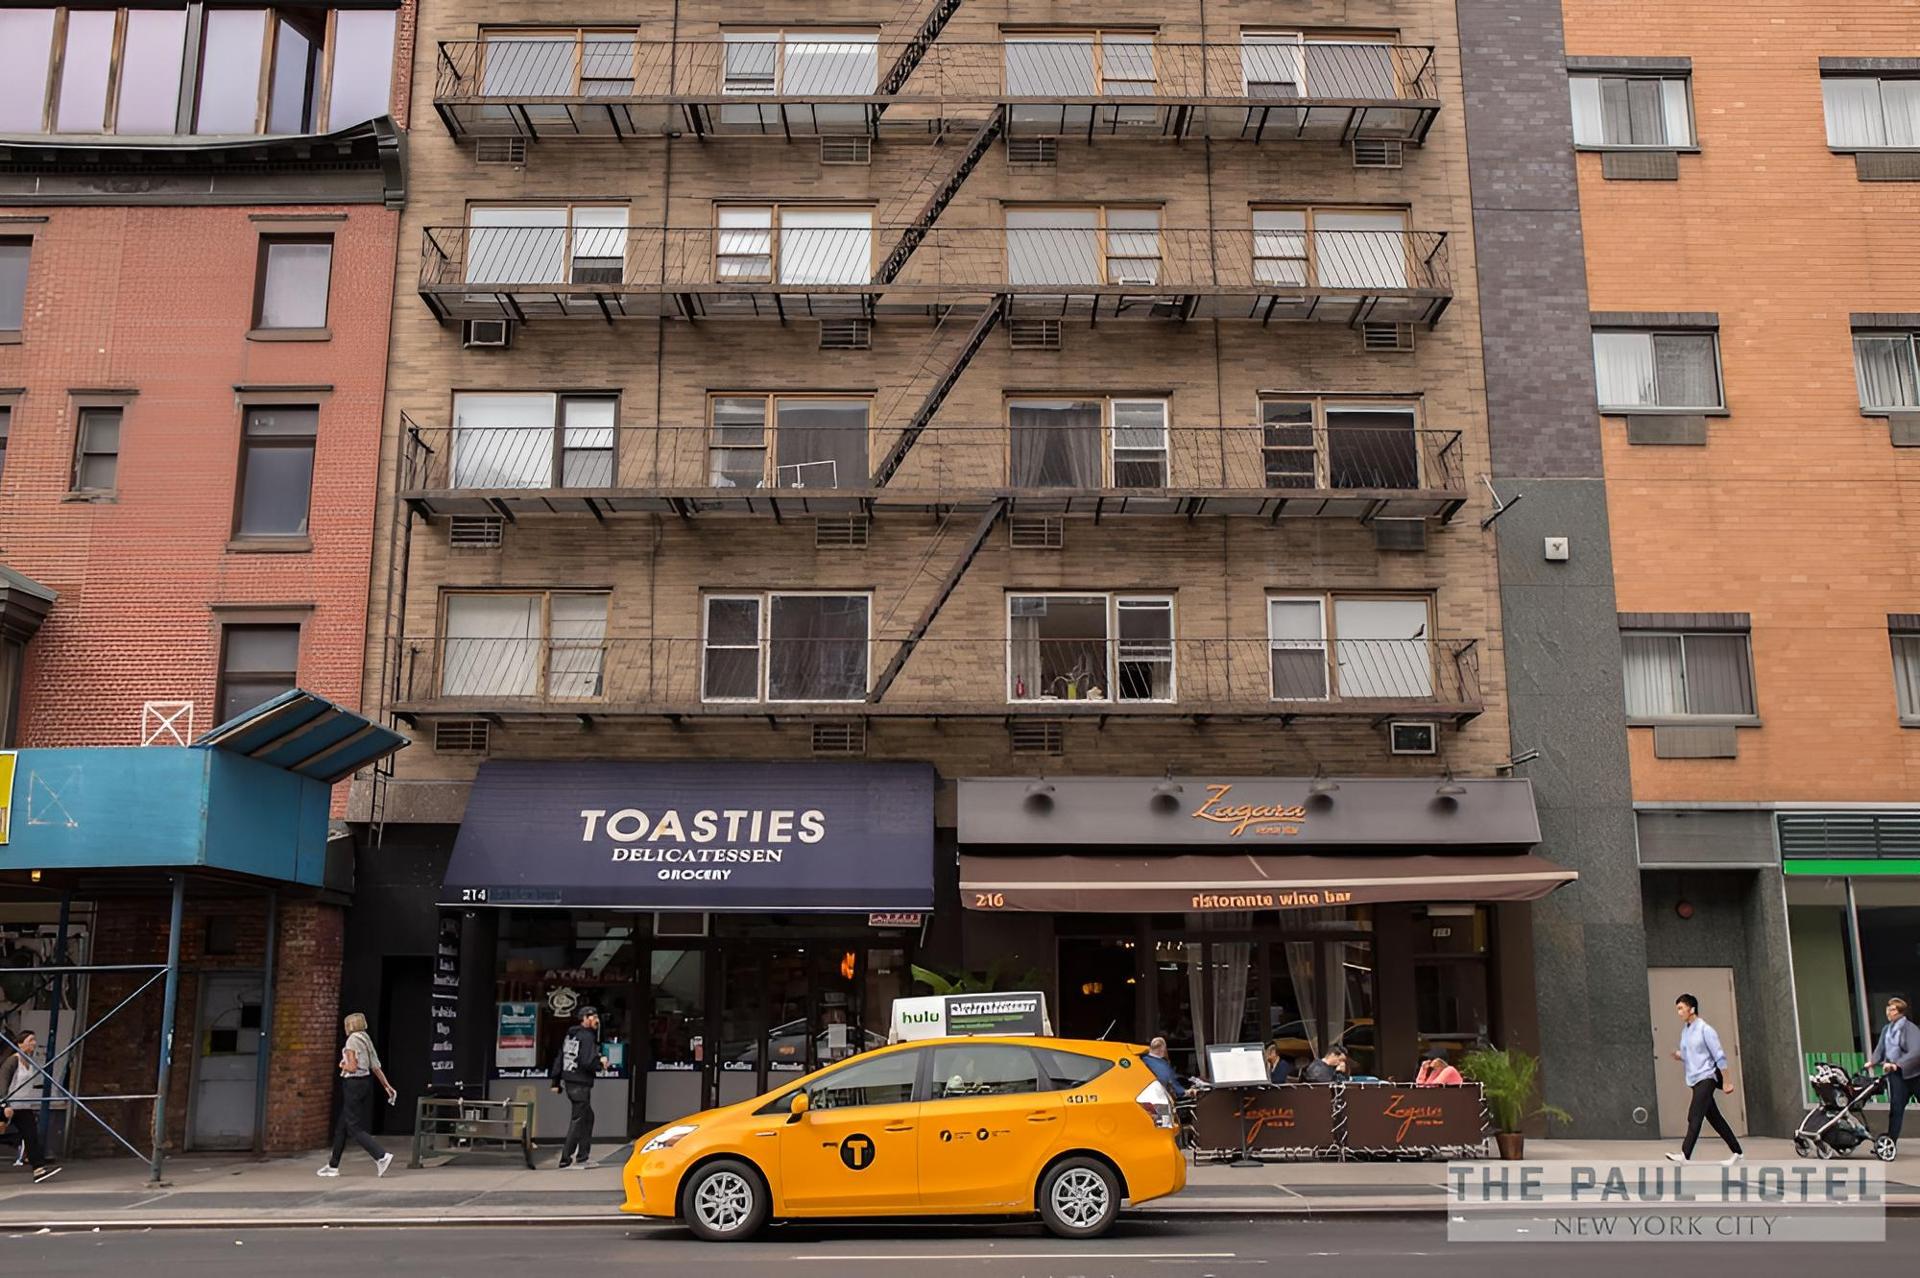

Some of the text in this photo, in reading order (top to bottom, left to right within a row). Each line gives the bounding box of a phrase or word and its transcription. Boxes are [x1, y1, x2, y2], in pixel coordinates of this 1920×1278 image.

[1191, 783, 1306, 837] Zagara
[580, 808, 826, 844] TOASTIES
[611, 848, 783, 863] DELICATESSEN
[657, 869, 732, 880] GROCERY
[462, 889, 487, 901] 214
[975, 893, 1004, 907] 216
[1192, 890, 1353, 908] ristorante wine bar
[902, 1010, 940, 1024] hulu
[847, 1140, 868, 1166] T
